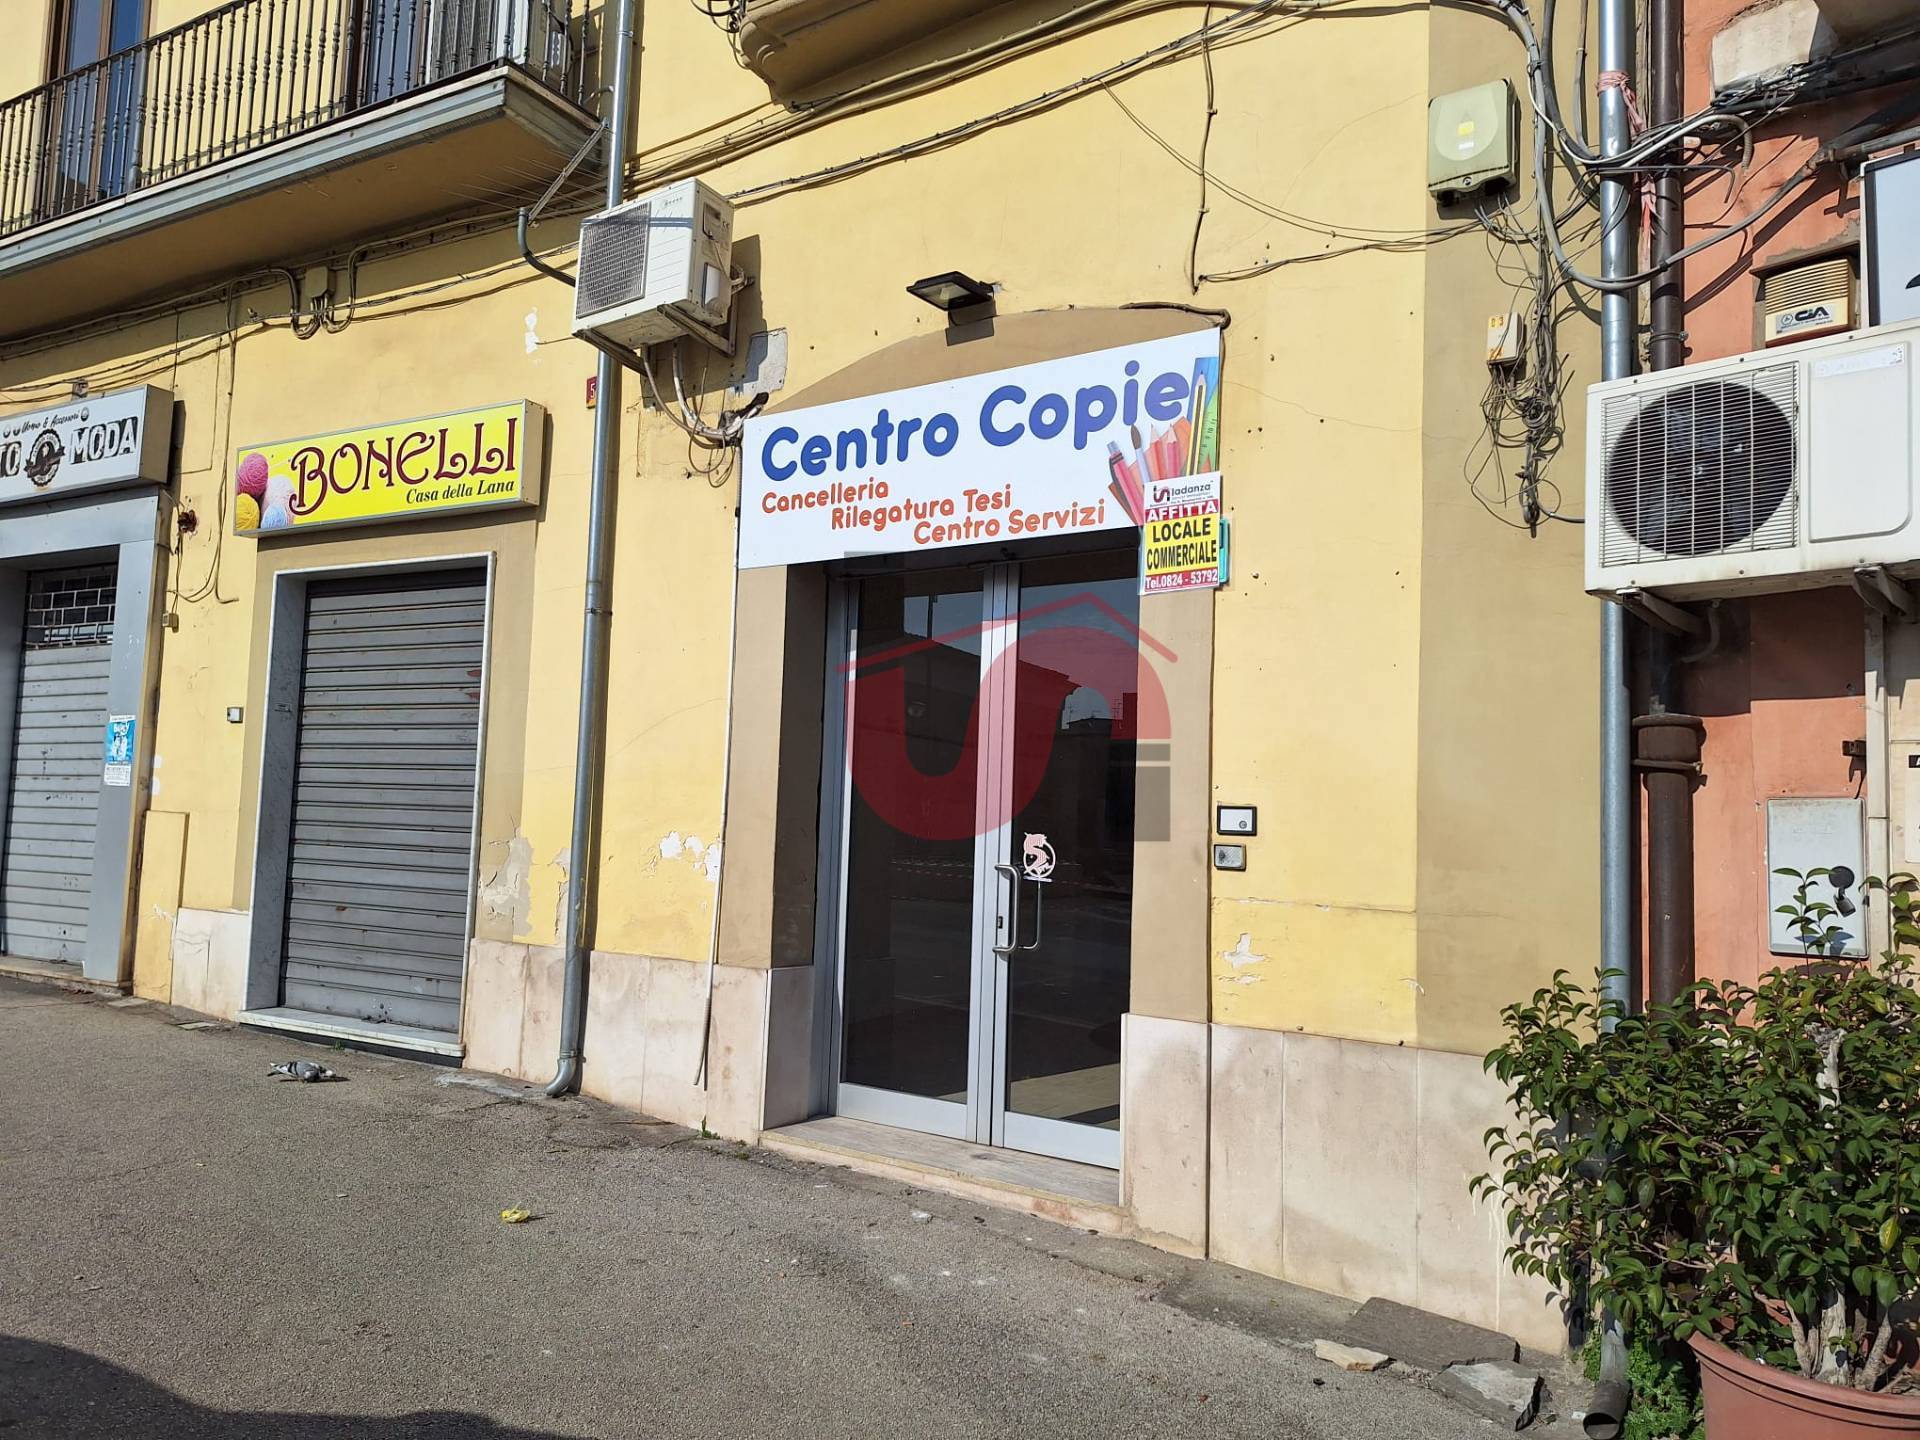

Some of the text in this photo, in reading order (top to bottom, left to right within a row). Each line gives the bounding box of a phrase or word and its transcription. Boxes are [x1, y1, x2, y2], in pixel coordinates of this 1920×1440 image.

[761, 360, 1190, 482] Centro Copie
[69, 416, 139, 465] MODA
[288, 417, 518, 516] BONELLI
[406, 479, 515, 504] Casa della Lana
[761, 476, 889, 514] Cancelleria
[831, 483, 1011, 532] Rilegatura Tesi
[913, 498, 1105, 545] Centro Servizi
[1146, 500, 1218, 523] AFFITTA
[1152, 517, 1211, 543] LOCALE
[1146, 539, 1217, 570] COMMERCIALE
[1145, 574, 1182, 589] Tel.0824
[1190, 569, 1218, 585] 53792
